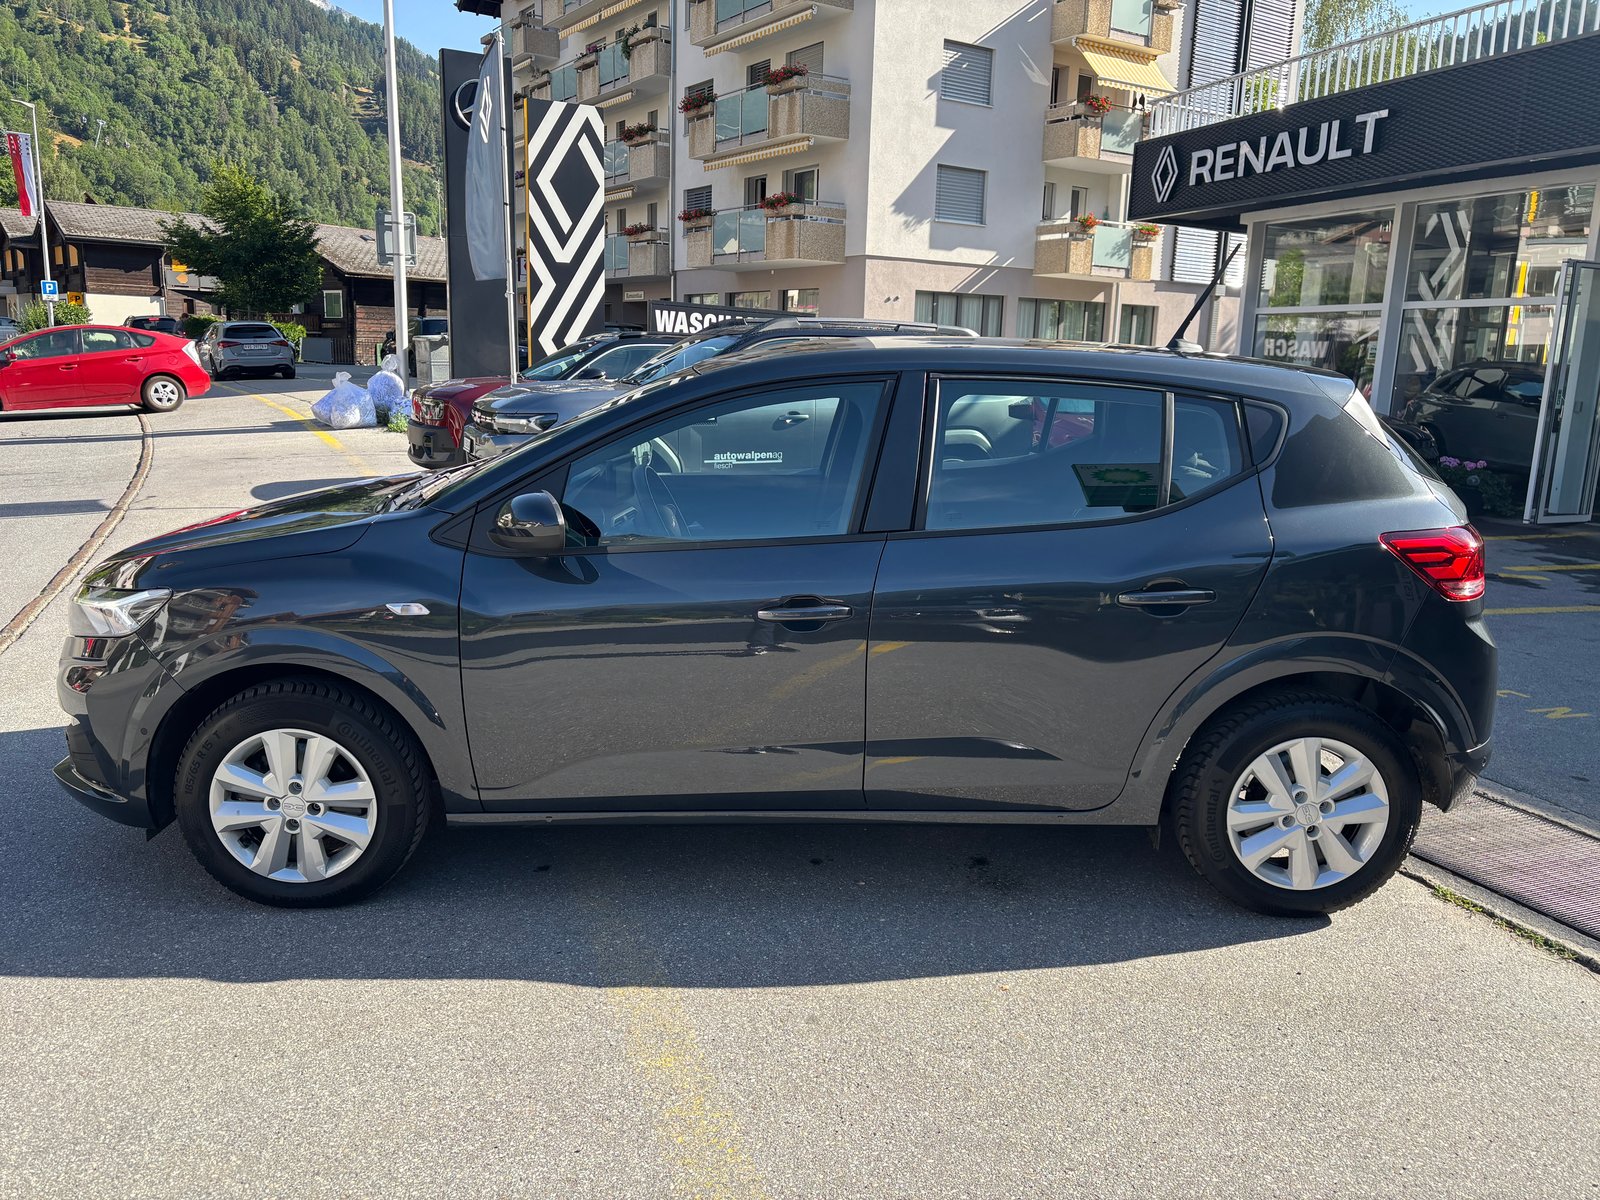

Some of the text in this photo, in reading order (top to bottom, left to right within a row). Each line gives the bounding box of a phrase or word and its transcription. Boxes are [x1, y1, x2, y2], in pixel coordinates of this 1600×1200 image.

[1189, 108, 1389, 186] RENAULT
[46, 283, 53, 293] P
[337, 721, 397, 786] Continental
[1204, 788, 1226, 862] Continental
